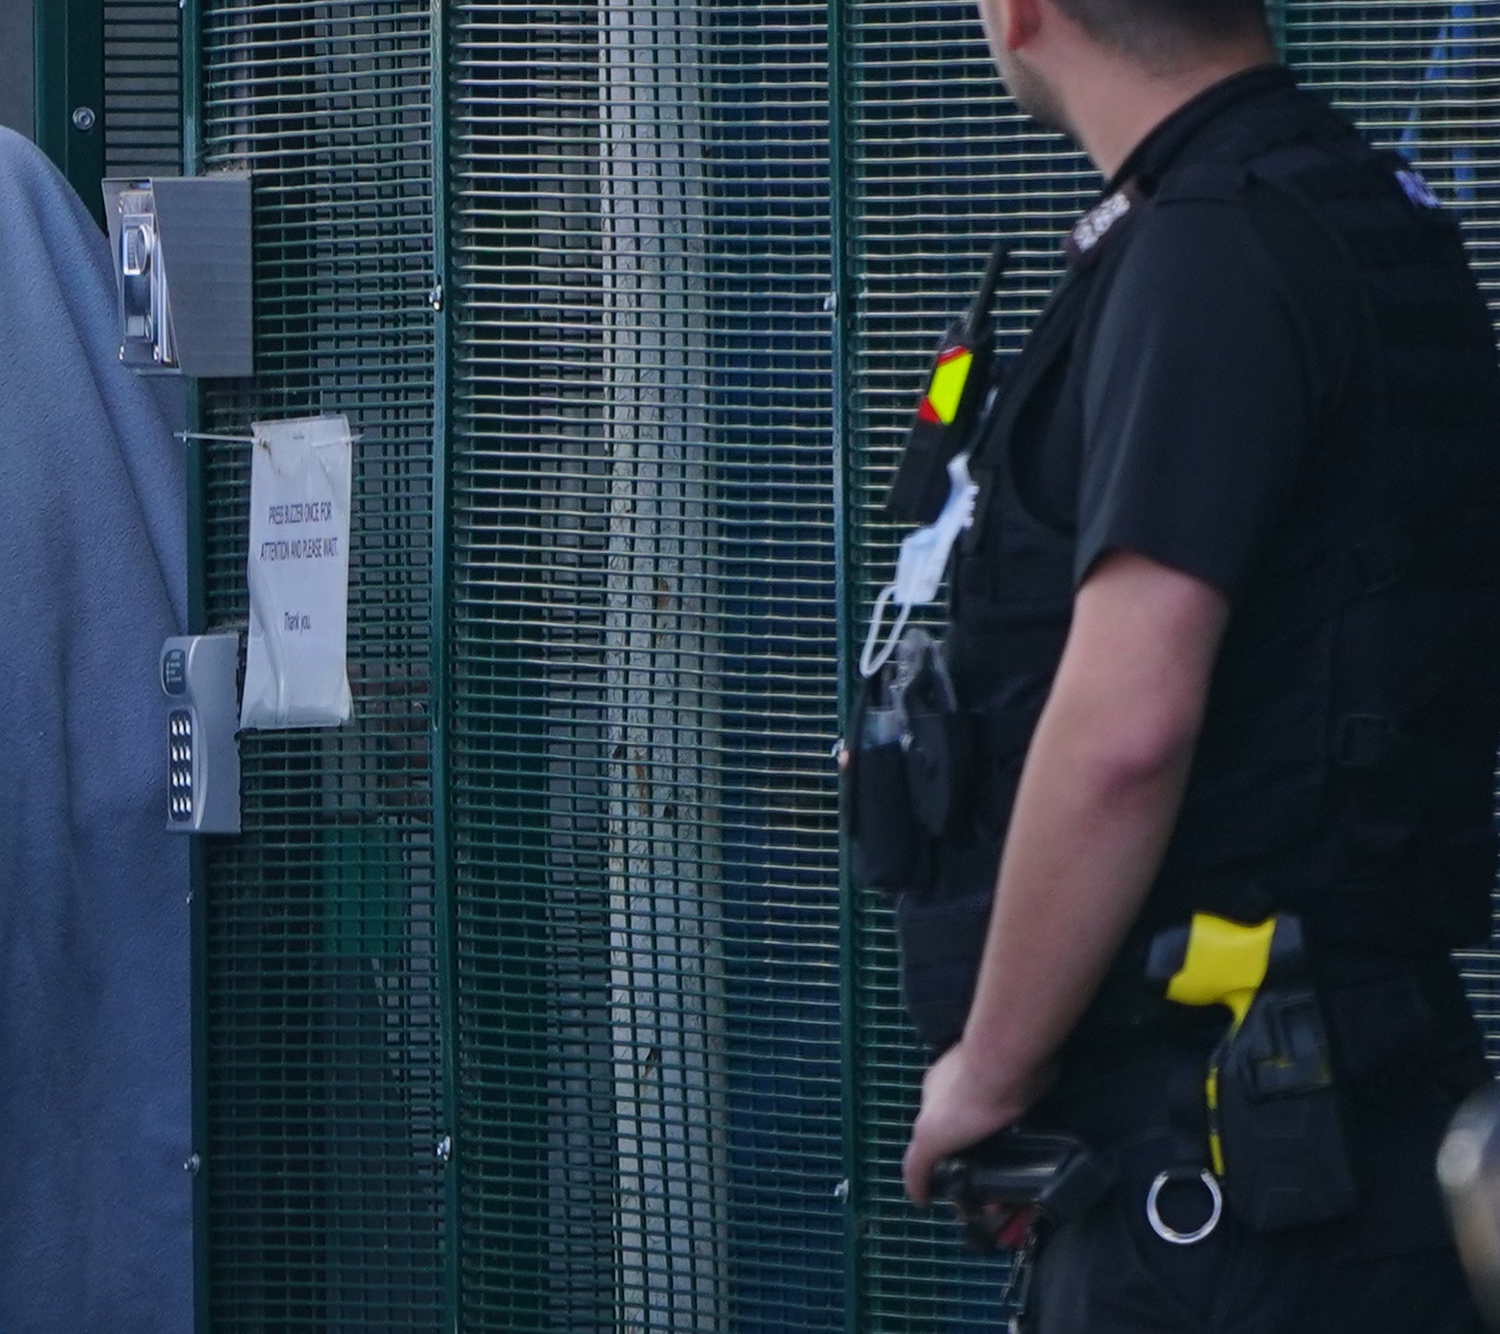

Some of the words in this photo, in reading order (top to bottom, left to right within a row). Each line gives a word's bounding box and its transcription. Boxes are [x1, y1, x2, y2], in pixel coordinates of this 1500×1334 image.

[269, 506, 283, 525] PRESS
[304, 502, 319, 523] ONCE
[320, 501, 332, 522] FOR
[260, 539, 290, 561] ATTENTION
[291, 539, 301, 559] AND
[302, 538, 322, 559] PLEASE
